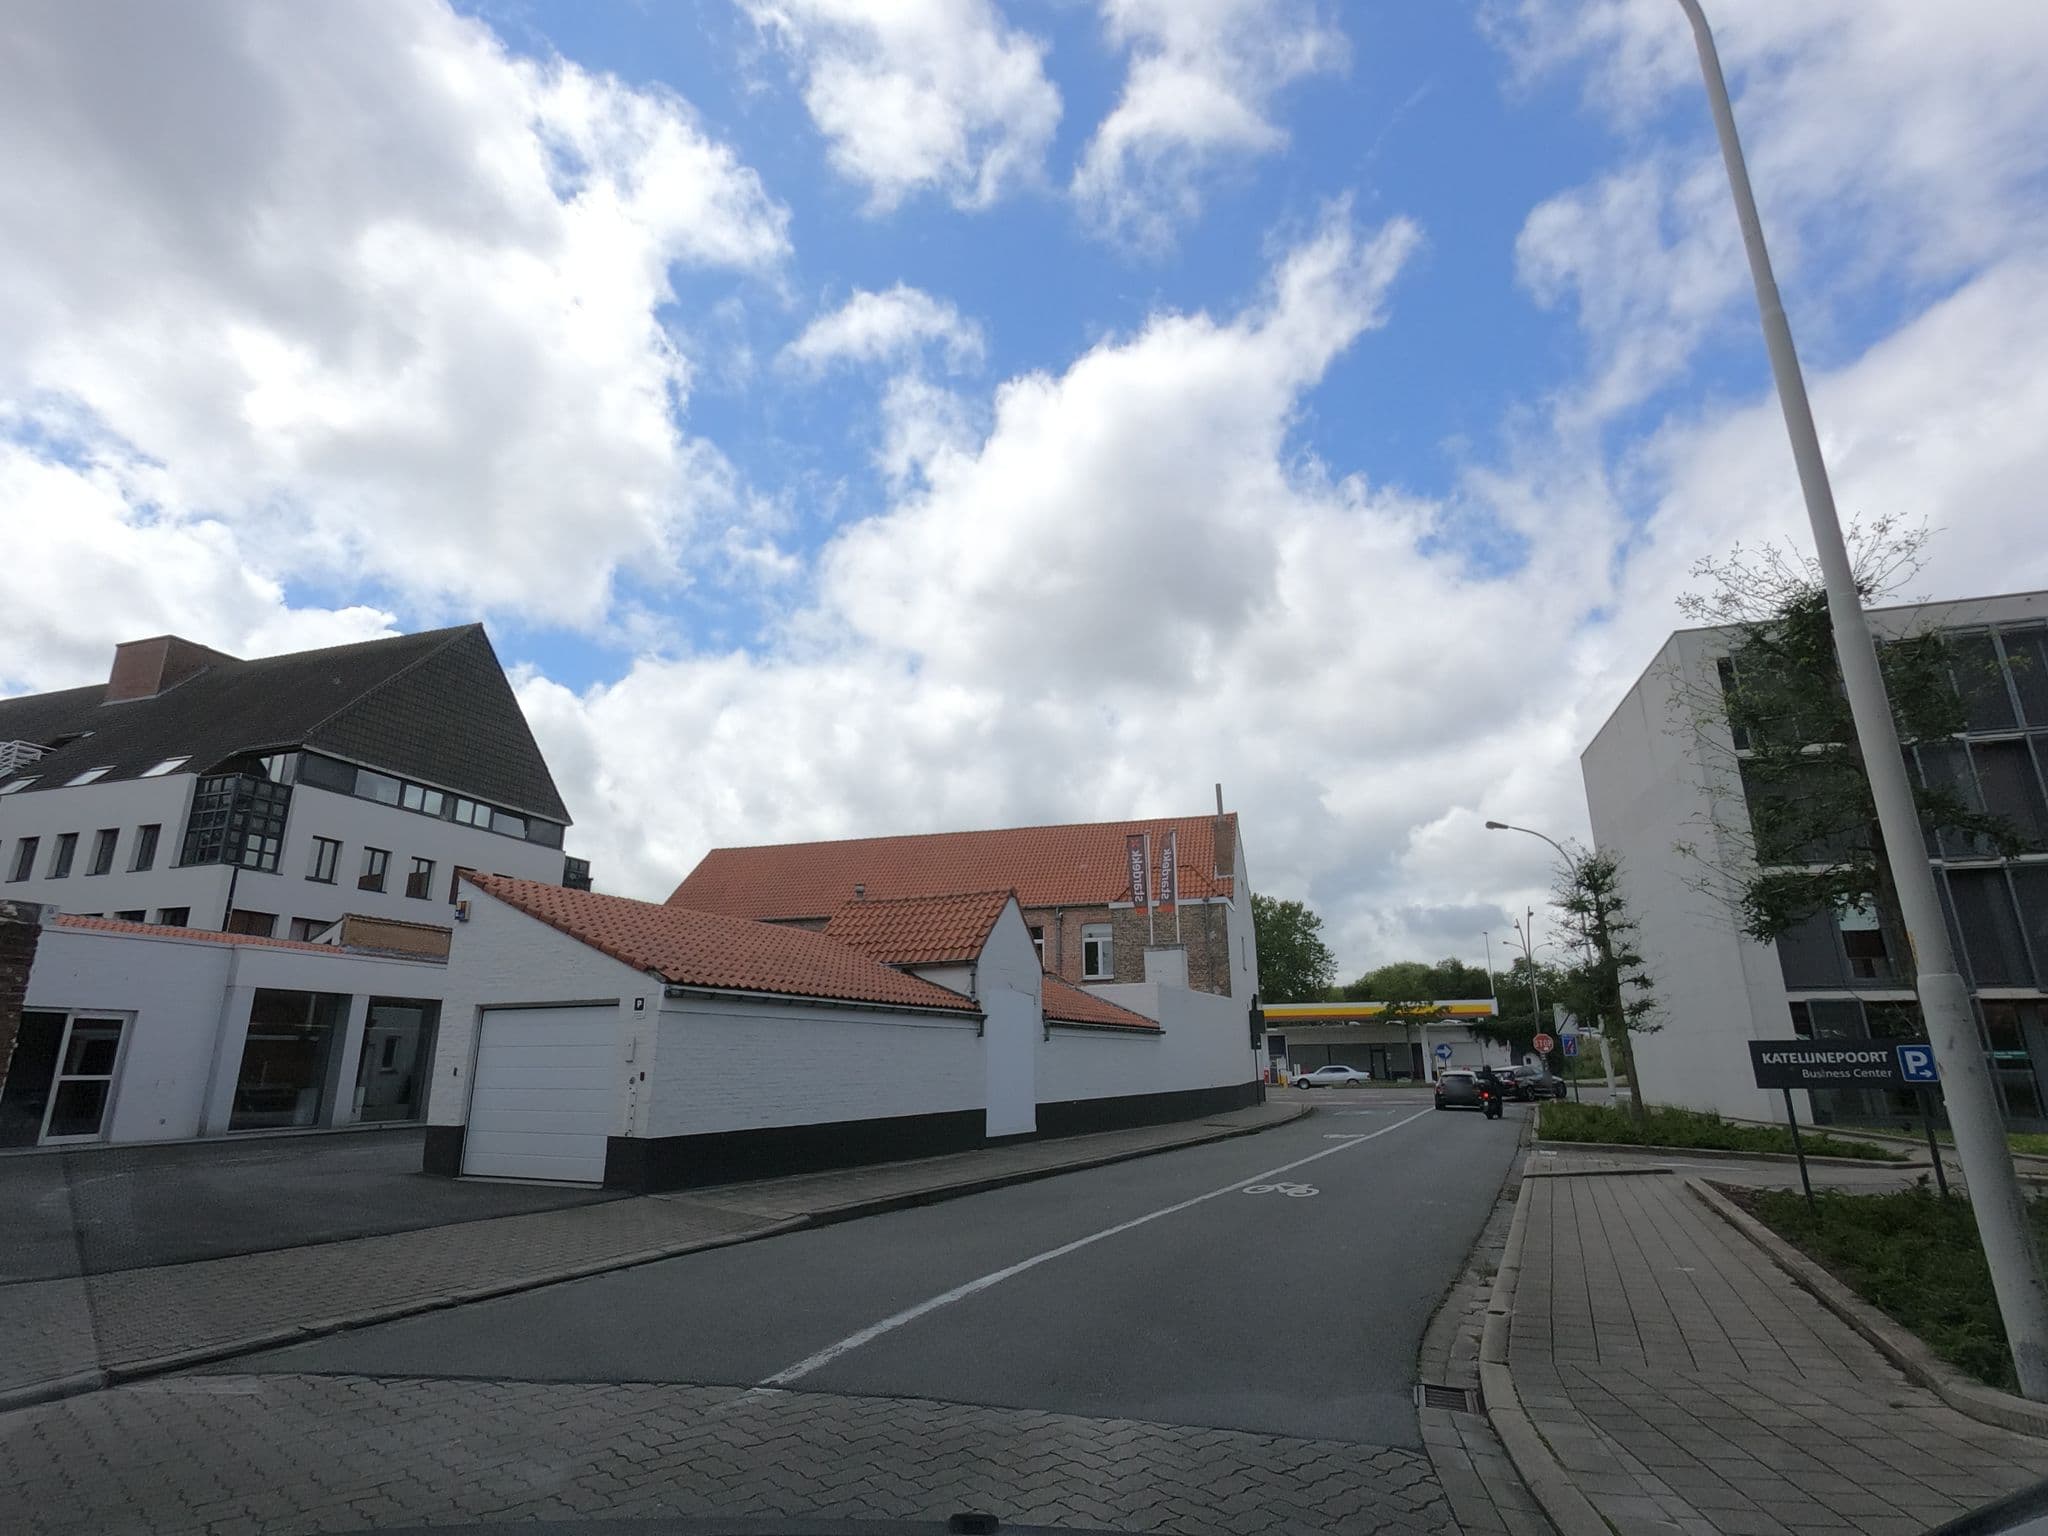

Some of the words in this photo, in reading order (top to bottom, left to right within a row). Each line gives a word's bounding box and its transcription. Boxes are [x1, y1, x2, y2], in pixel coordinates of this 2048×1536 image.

[1535, 1039, 1553, 1047] STOP
[1762, 1051, 1888, 1064] KATELIJNEPOORT
[1905, 1050, 1928, 1074] P
[1802, 1068, 1851, 1079] Business
[1853, 1068, 1893, 1078] Center
